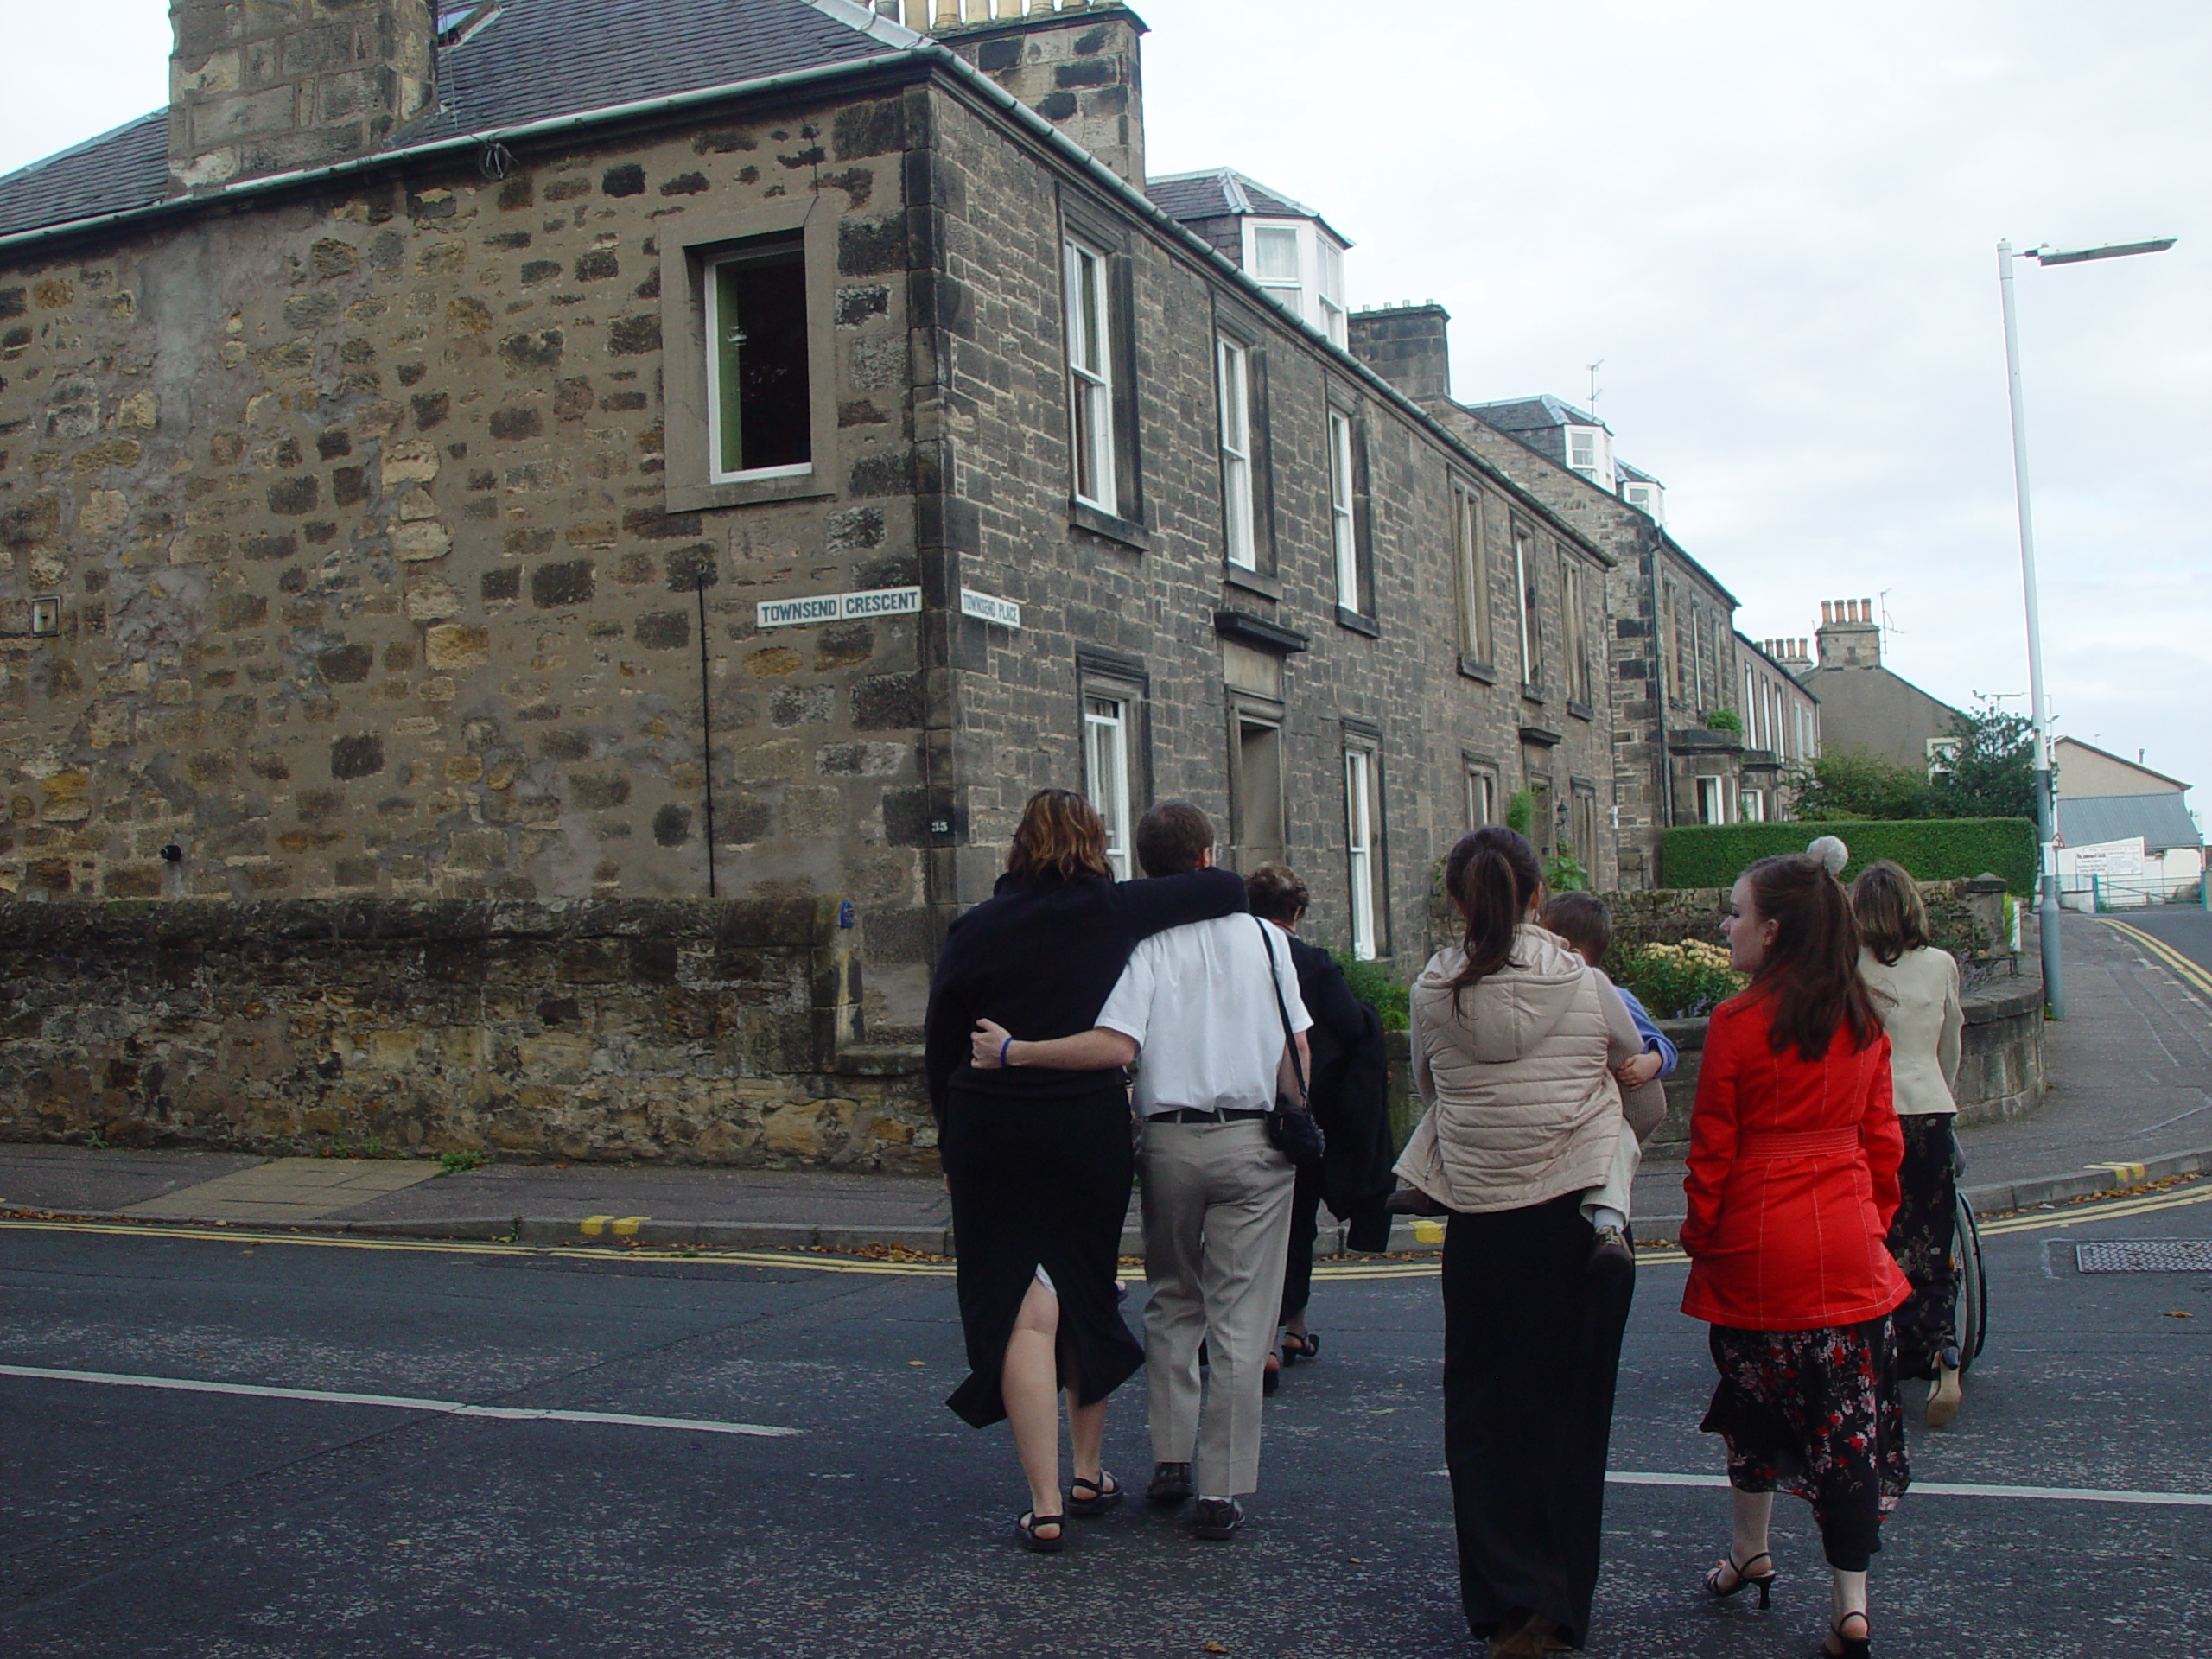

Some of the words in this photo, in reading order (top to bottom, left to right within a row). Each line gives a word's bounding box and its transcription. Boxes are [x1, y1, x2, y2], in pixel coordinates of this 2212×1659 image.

[761, 599, 837, 623] TOWNSEND
[845, 591, 918, 615] CRESCENT
[963, 593, 996, 618] TOWNSEND
[998, 602, 1018, 623] PLACE
[931, 821, 949, 833] 35
